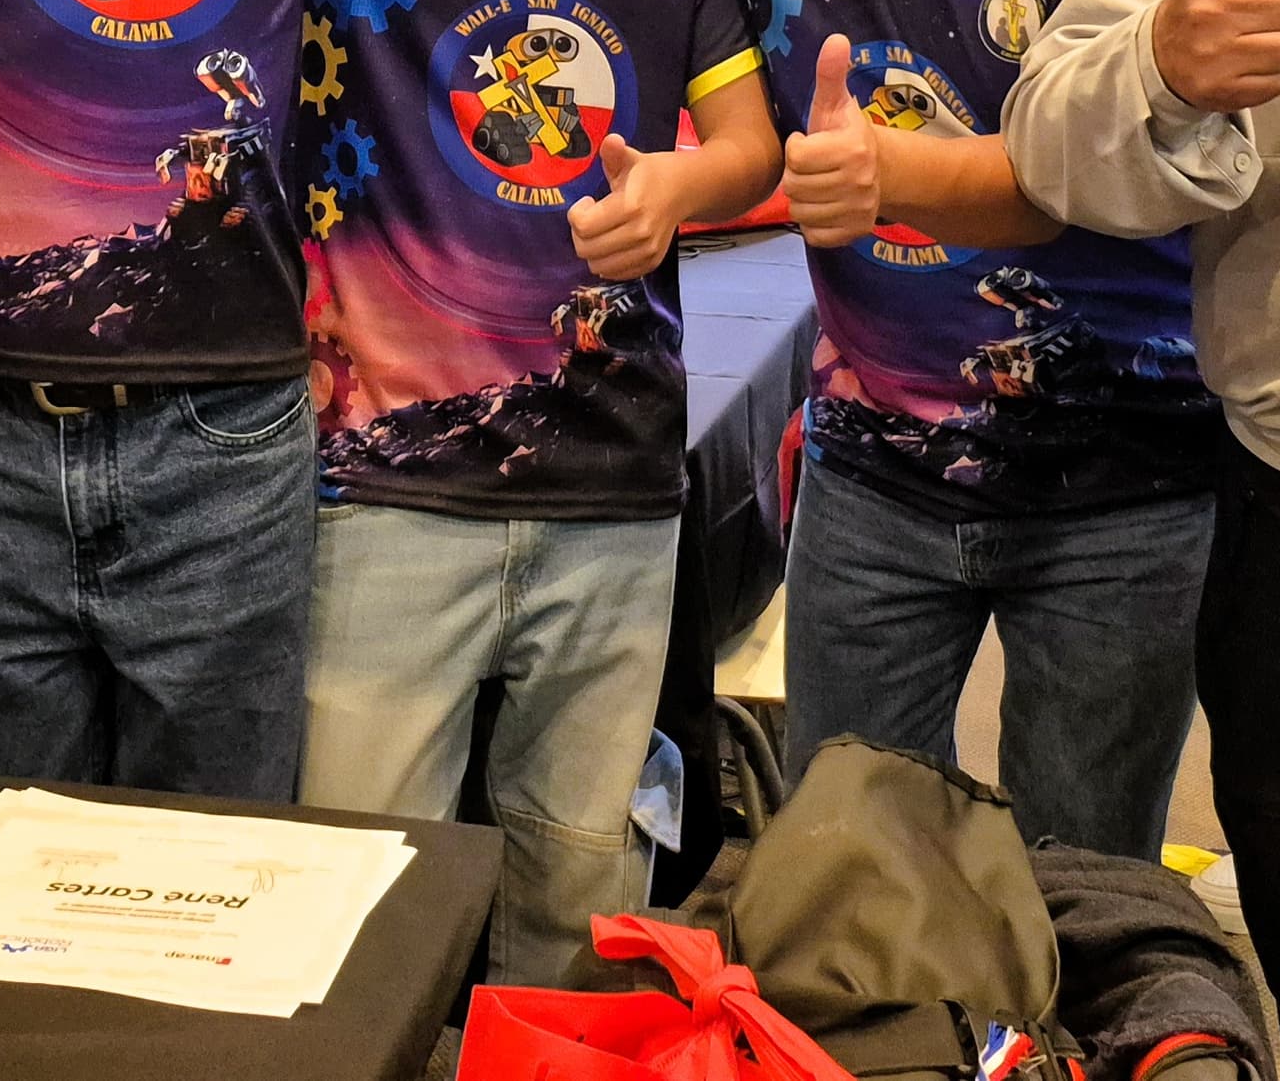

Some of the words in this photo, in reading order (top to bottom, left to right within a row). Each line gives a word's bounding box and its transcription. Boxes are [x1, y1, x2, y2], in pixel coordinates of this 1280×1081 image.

[91, 15, 174, 42] CALAMA
[571, 2, 624, 55] IGNACIO
[886, 46, 913, 65] SAN
[923, 66, 975, 128] IGNACIO
[496, 181, 566, 206] CALAMA
[872, 239, 951, 266] CALAMA
[45, 881, 154, 901] Cartes
[163, 890, 250, 909] René
